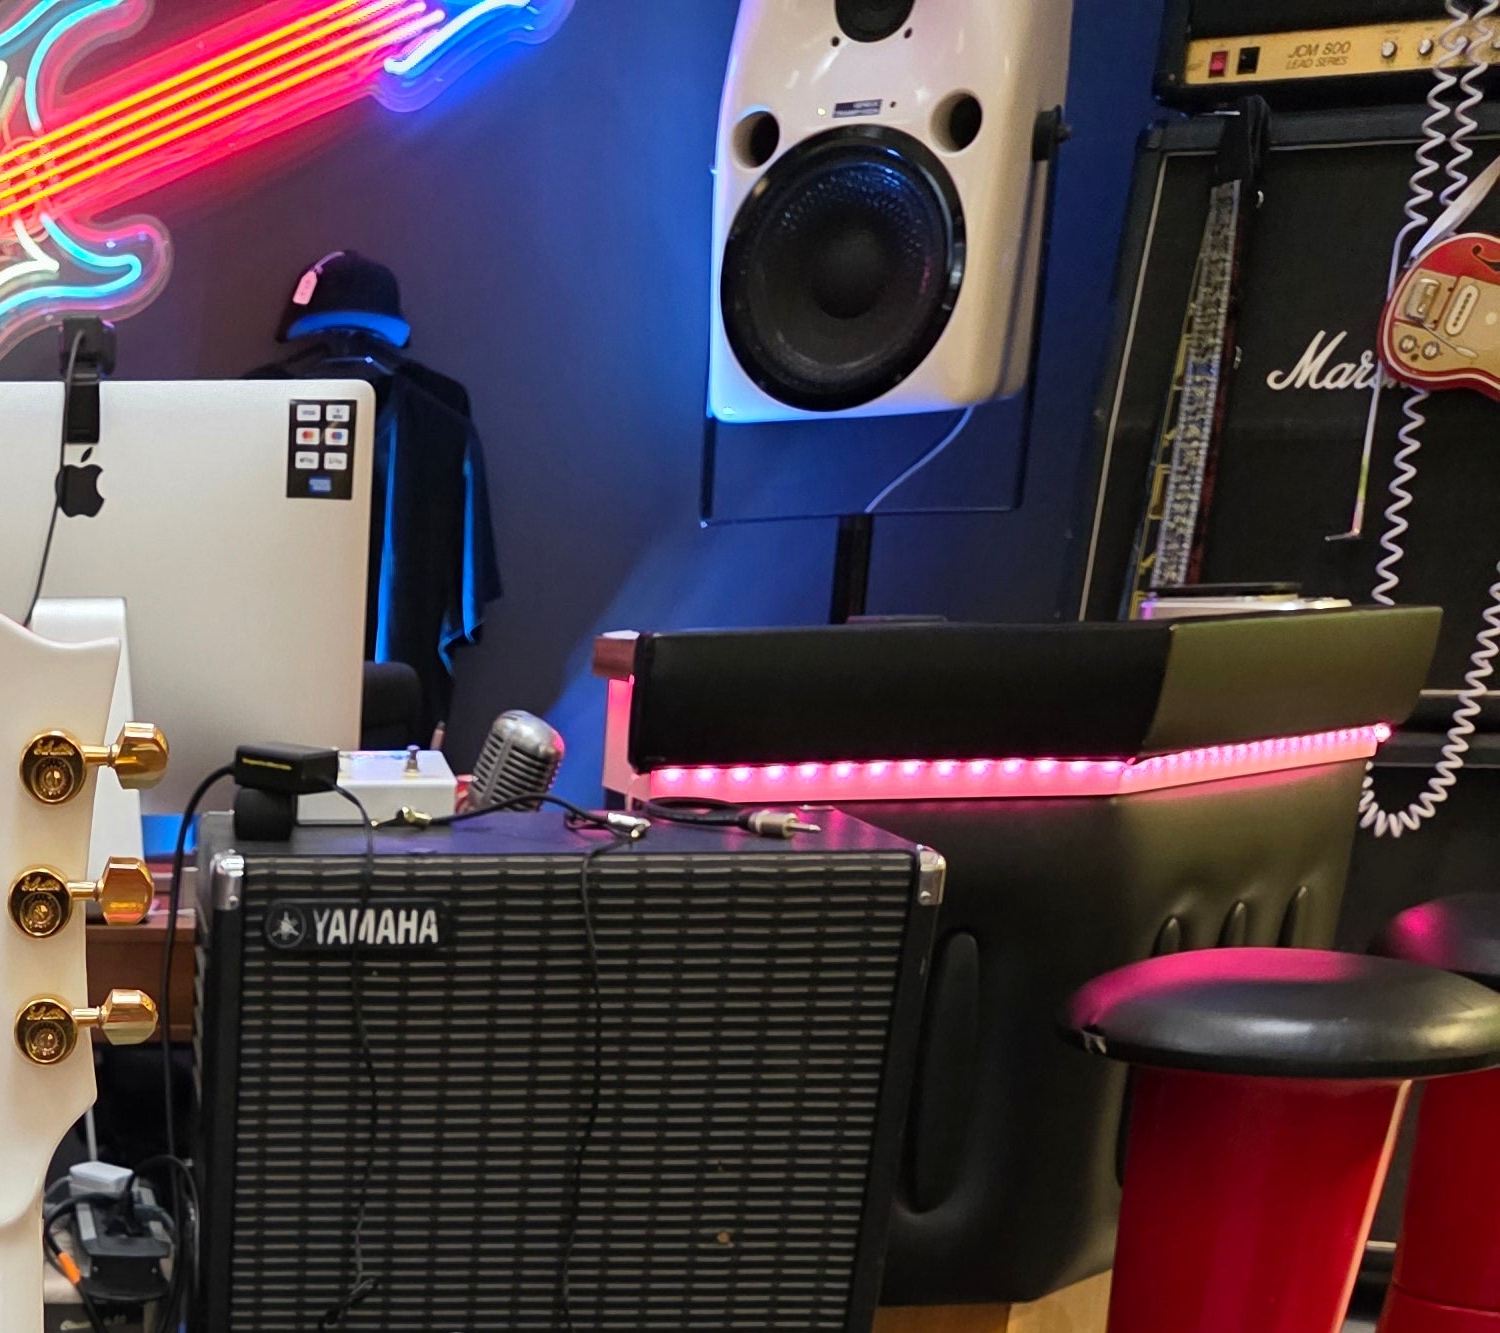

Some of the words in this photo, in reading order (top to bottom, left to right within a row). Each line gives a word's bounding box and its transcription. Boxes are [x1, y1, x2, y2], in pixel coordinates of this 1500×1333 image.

[1288, 44, 1319, 59] JCM
[1324, 40, 1351, 55] 800
[1285, 58, 1313, 70] LEAD
[1315, 56, 1348, 67] SERIES
[313, 908, 439, 945] YAMAHA
